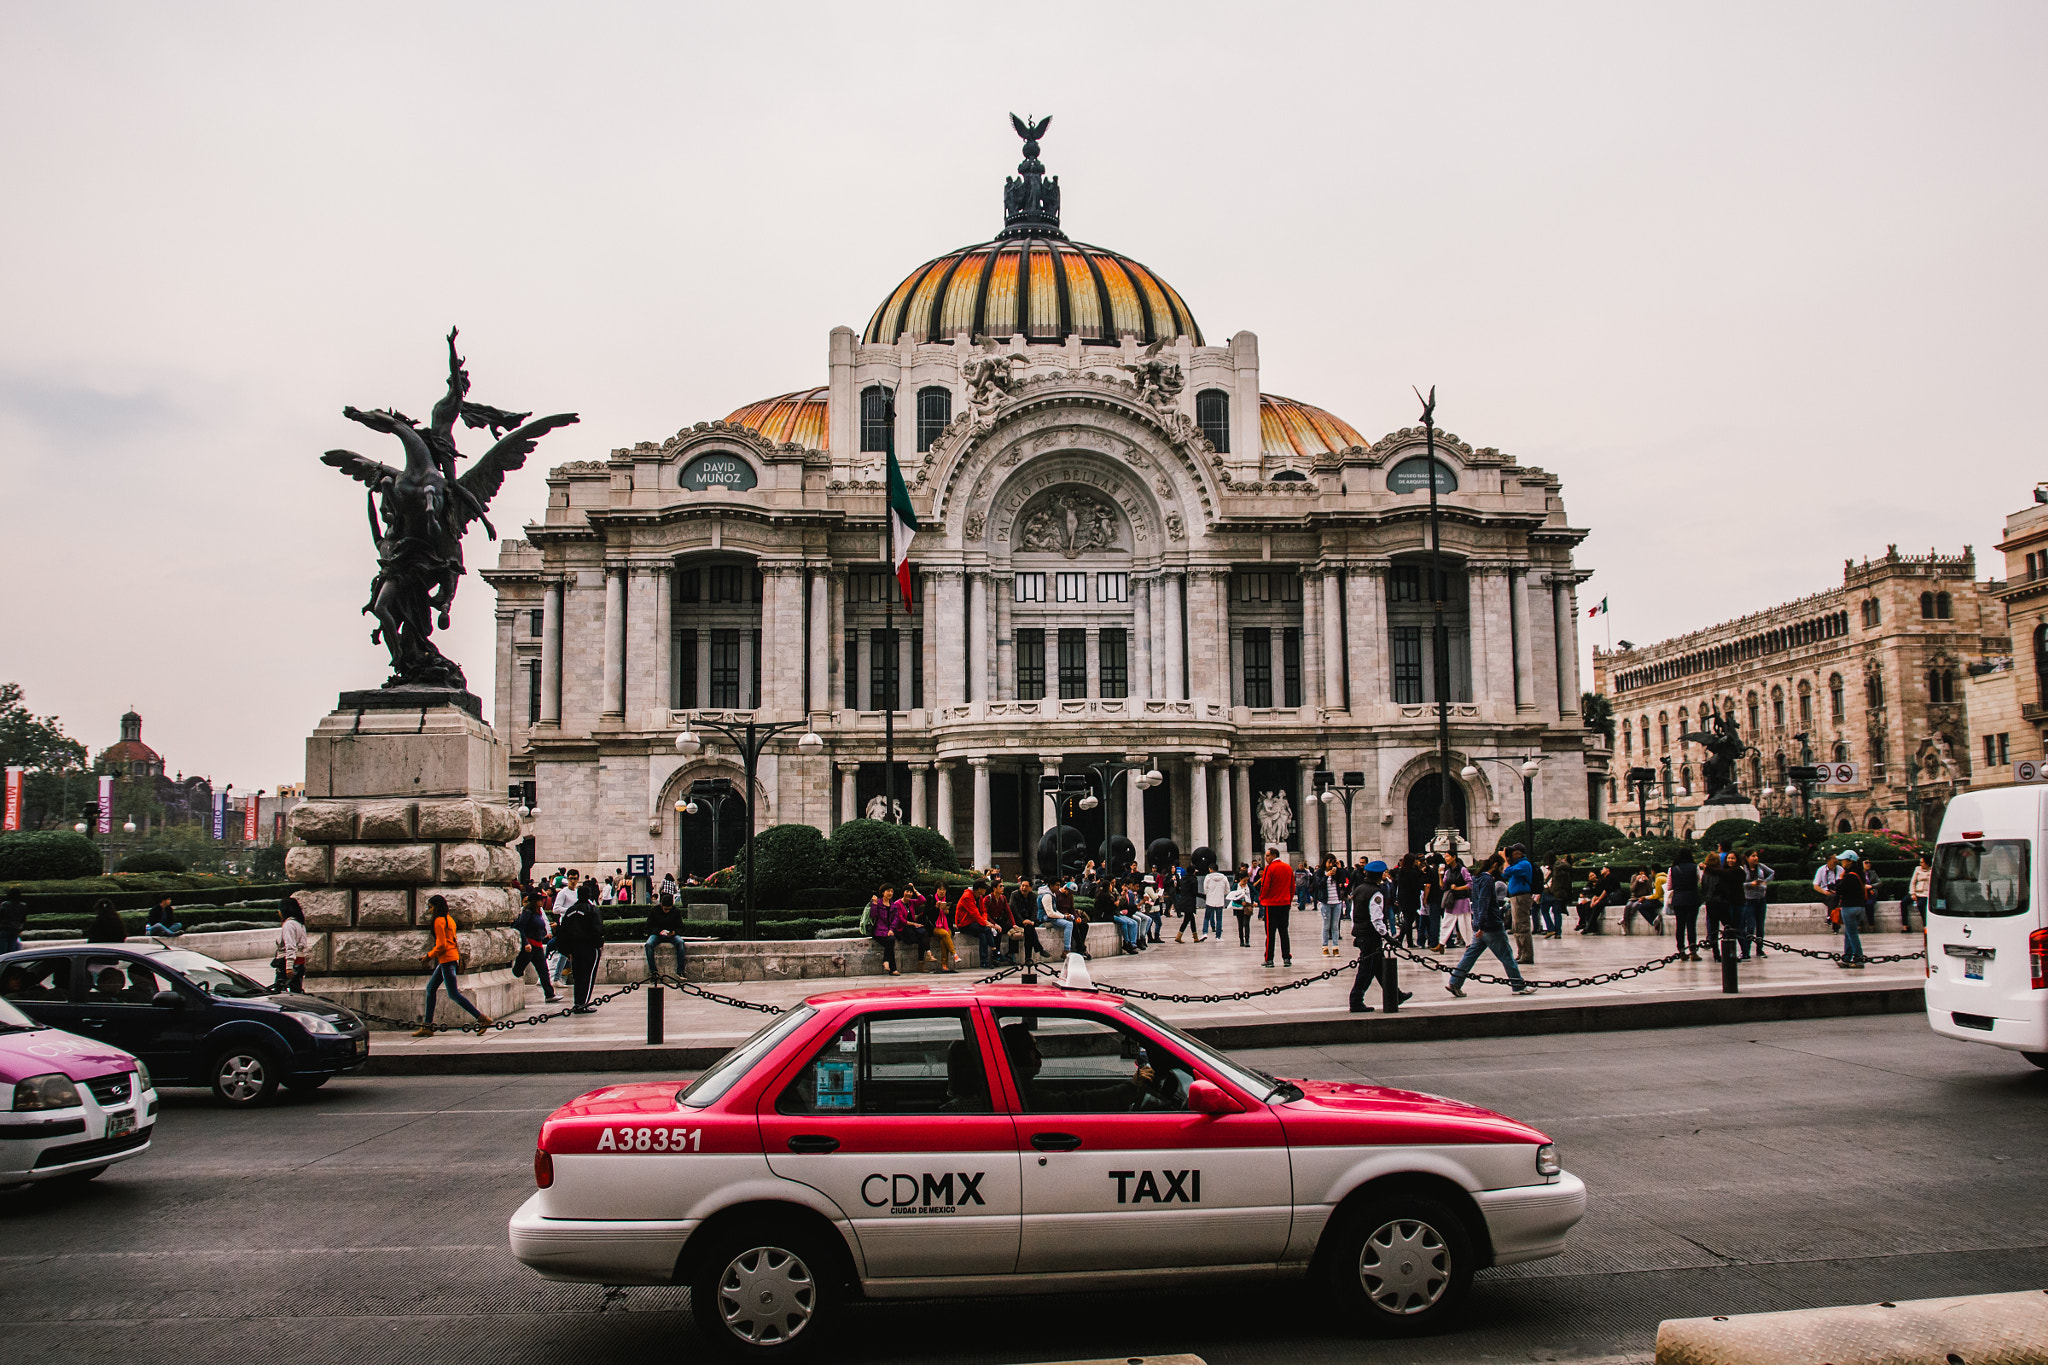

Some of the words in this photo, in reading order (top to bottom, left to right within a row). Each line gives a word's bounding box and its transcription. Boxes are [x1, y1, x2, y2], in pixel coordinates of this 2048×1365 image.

[696, 471, 741, 483] MUÑOZ
[703, 462, 736, 472] DAVID
[997, 486, 1032, 542] PALACIO
[1035, 473, 1056, 488] DE
[1063, 470, 1119, 495] BELLAS
[1121, 498, 1147, 542] ARTES
[99, 796, 109, 833] DANZA
[631, 857, 644, 873] E
[597, 1128, 702, 1152] A38351
[861, 1172, 986, 1208] CDMX
[1108, 1169, 1201, 1204] TAXI
[891, 1207, 917, 1215] CIUDAD
